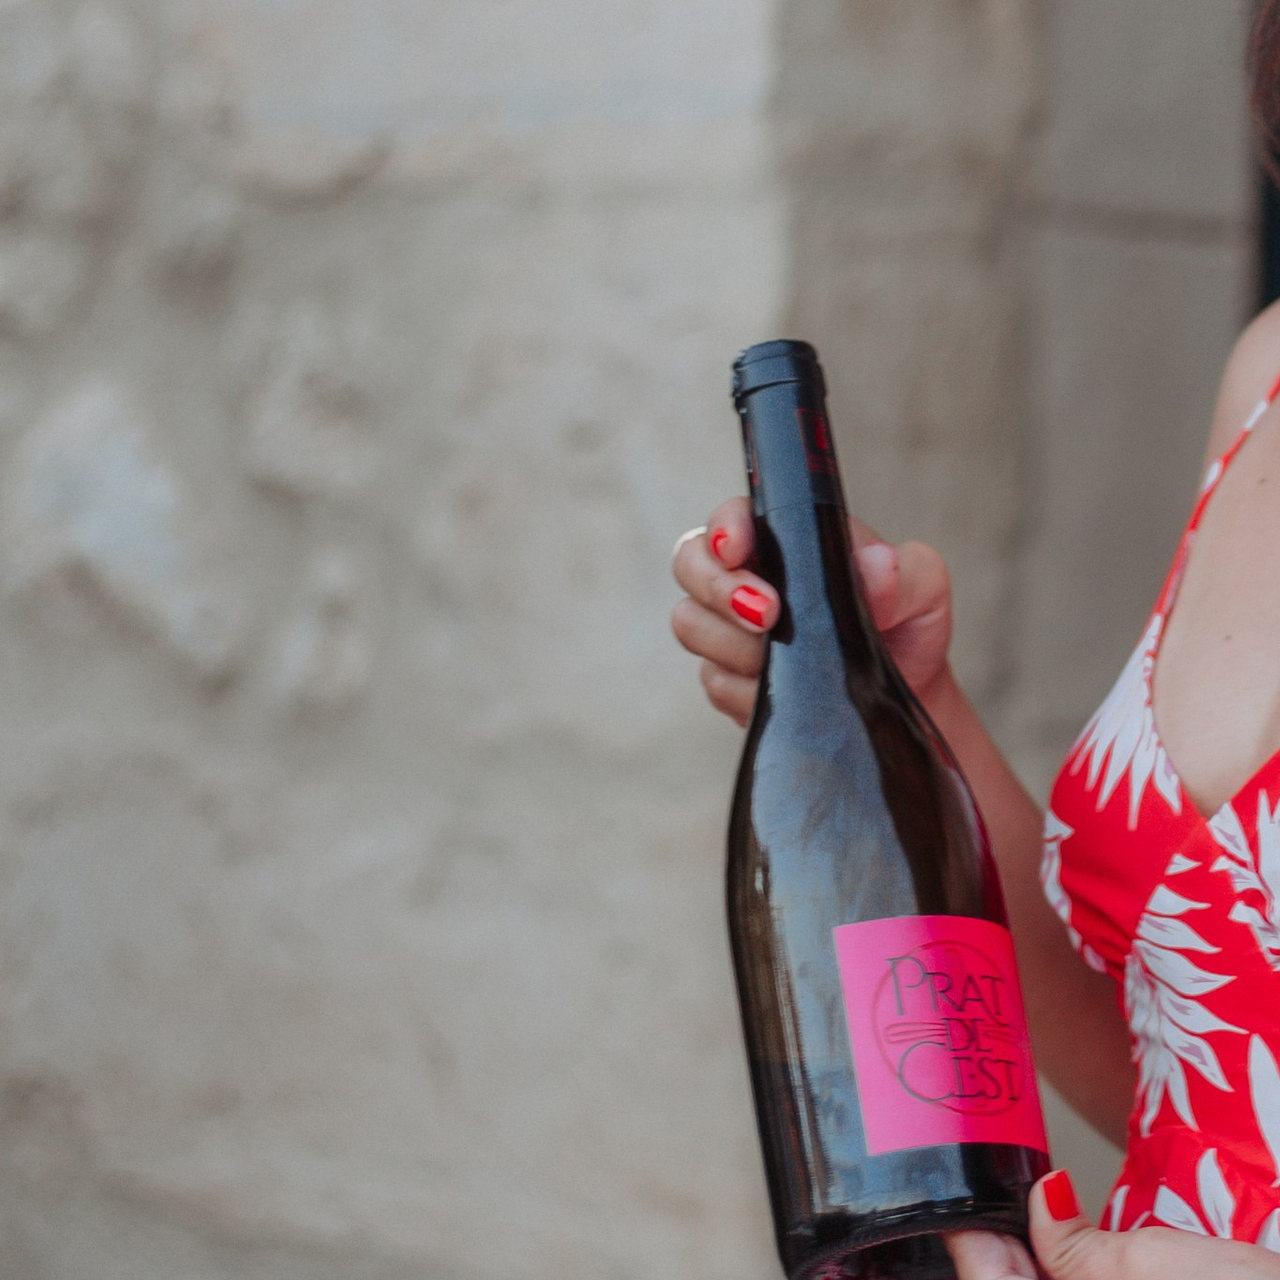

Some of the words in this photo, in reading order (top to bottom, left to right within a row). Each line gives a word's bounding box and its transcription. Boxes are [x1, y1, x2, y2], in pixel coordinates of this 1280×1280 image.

[885, 956, 1008, 1025] PRAT
[939, 1018, 992, 1052] DE
[899, 1041, 1018, 1102] CEST
